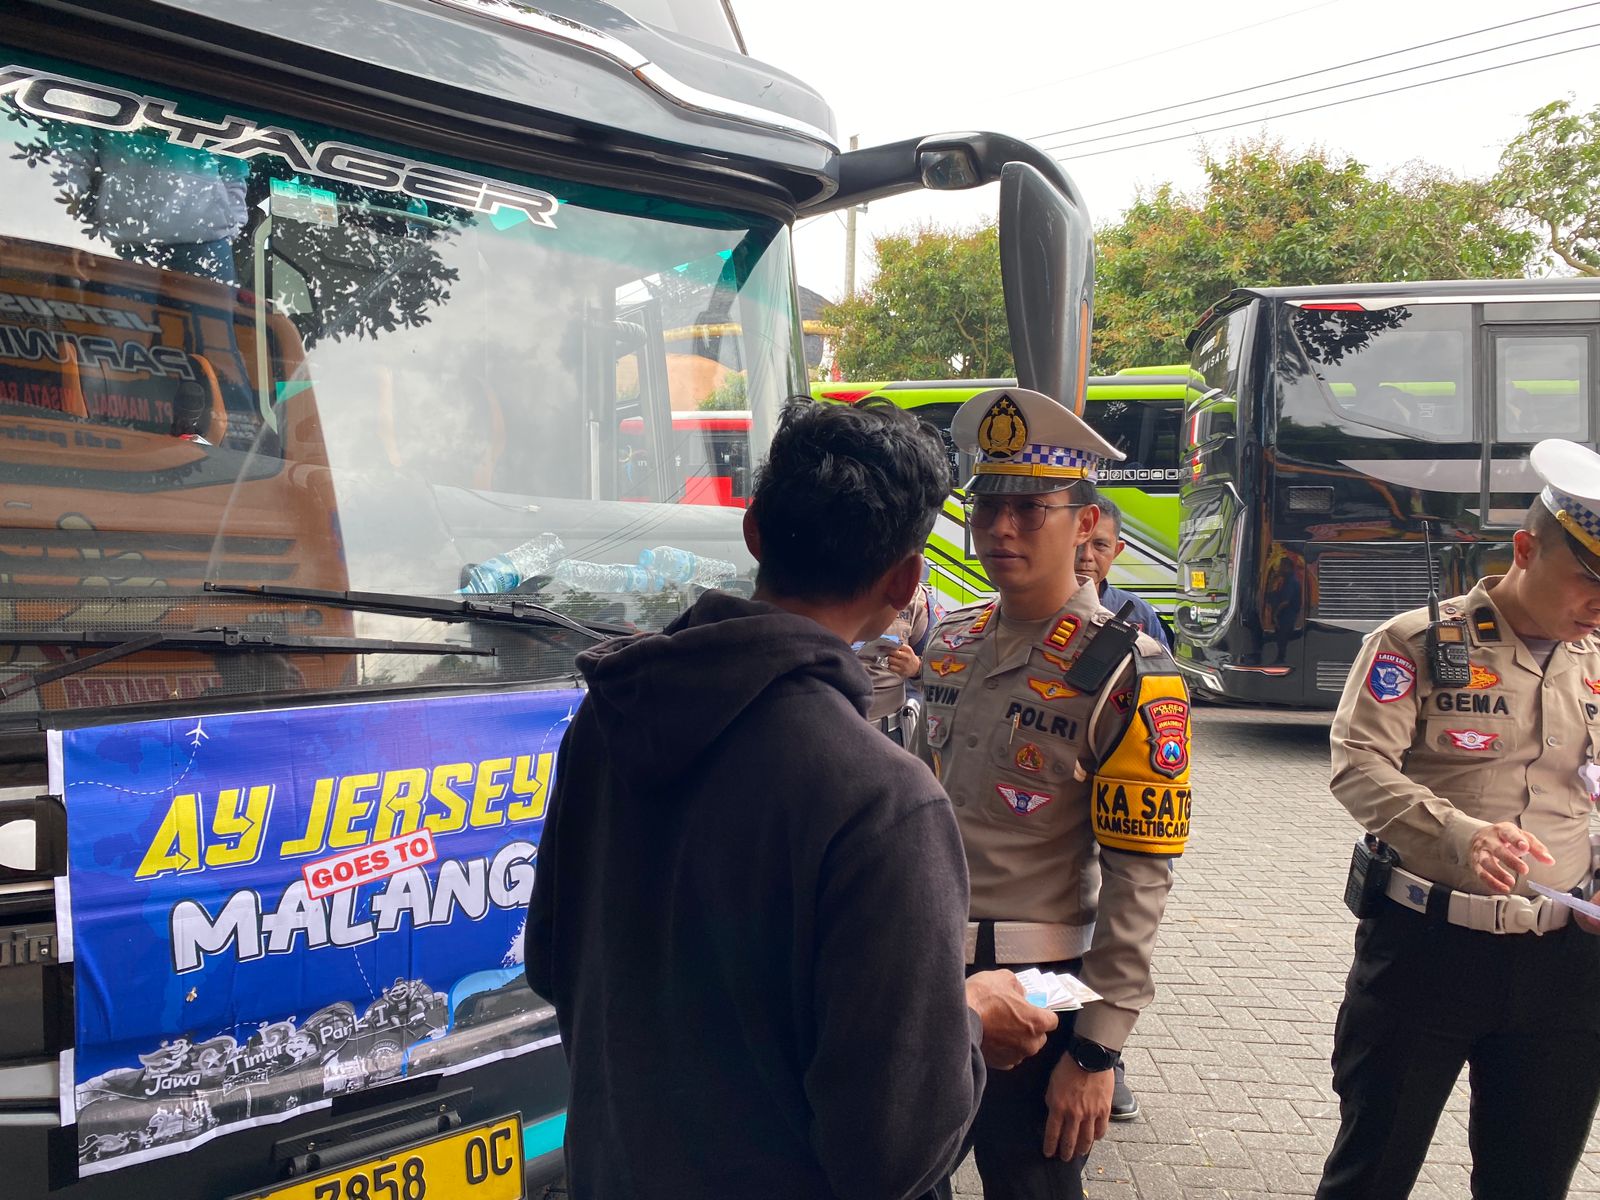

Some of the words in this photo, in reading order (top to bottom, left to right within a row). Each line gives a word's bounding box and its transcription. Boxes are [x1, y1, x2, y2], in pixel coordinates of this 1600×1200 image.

[1005, 702, 1077, 740] POLRI
[1153, 704, 1183, 713] POLRES
[1436, 691, 1509, 715] GEMA
[135, 784, 273, 881] AY
[280, 752, 553, 859] JERSEY
[1096, 782, 1129, 817] KA
[311, 849, 391, 889] GOES
[399, 836, 429, 864] TO
[170, 841, 539, 975] MALANG
[144, 1072, 201, 1096] Jawa
[227, 1041, 287, 1073] Timur
[320, 1014, 368, 1045] Park
[465, 1126, 513, 1185] OC
